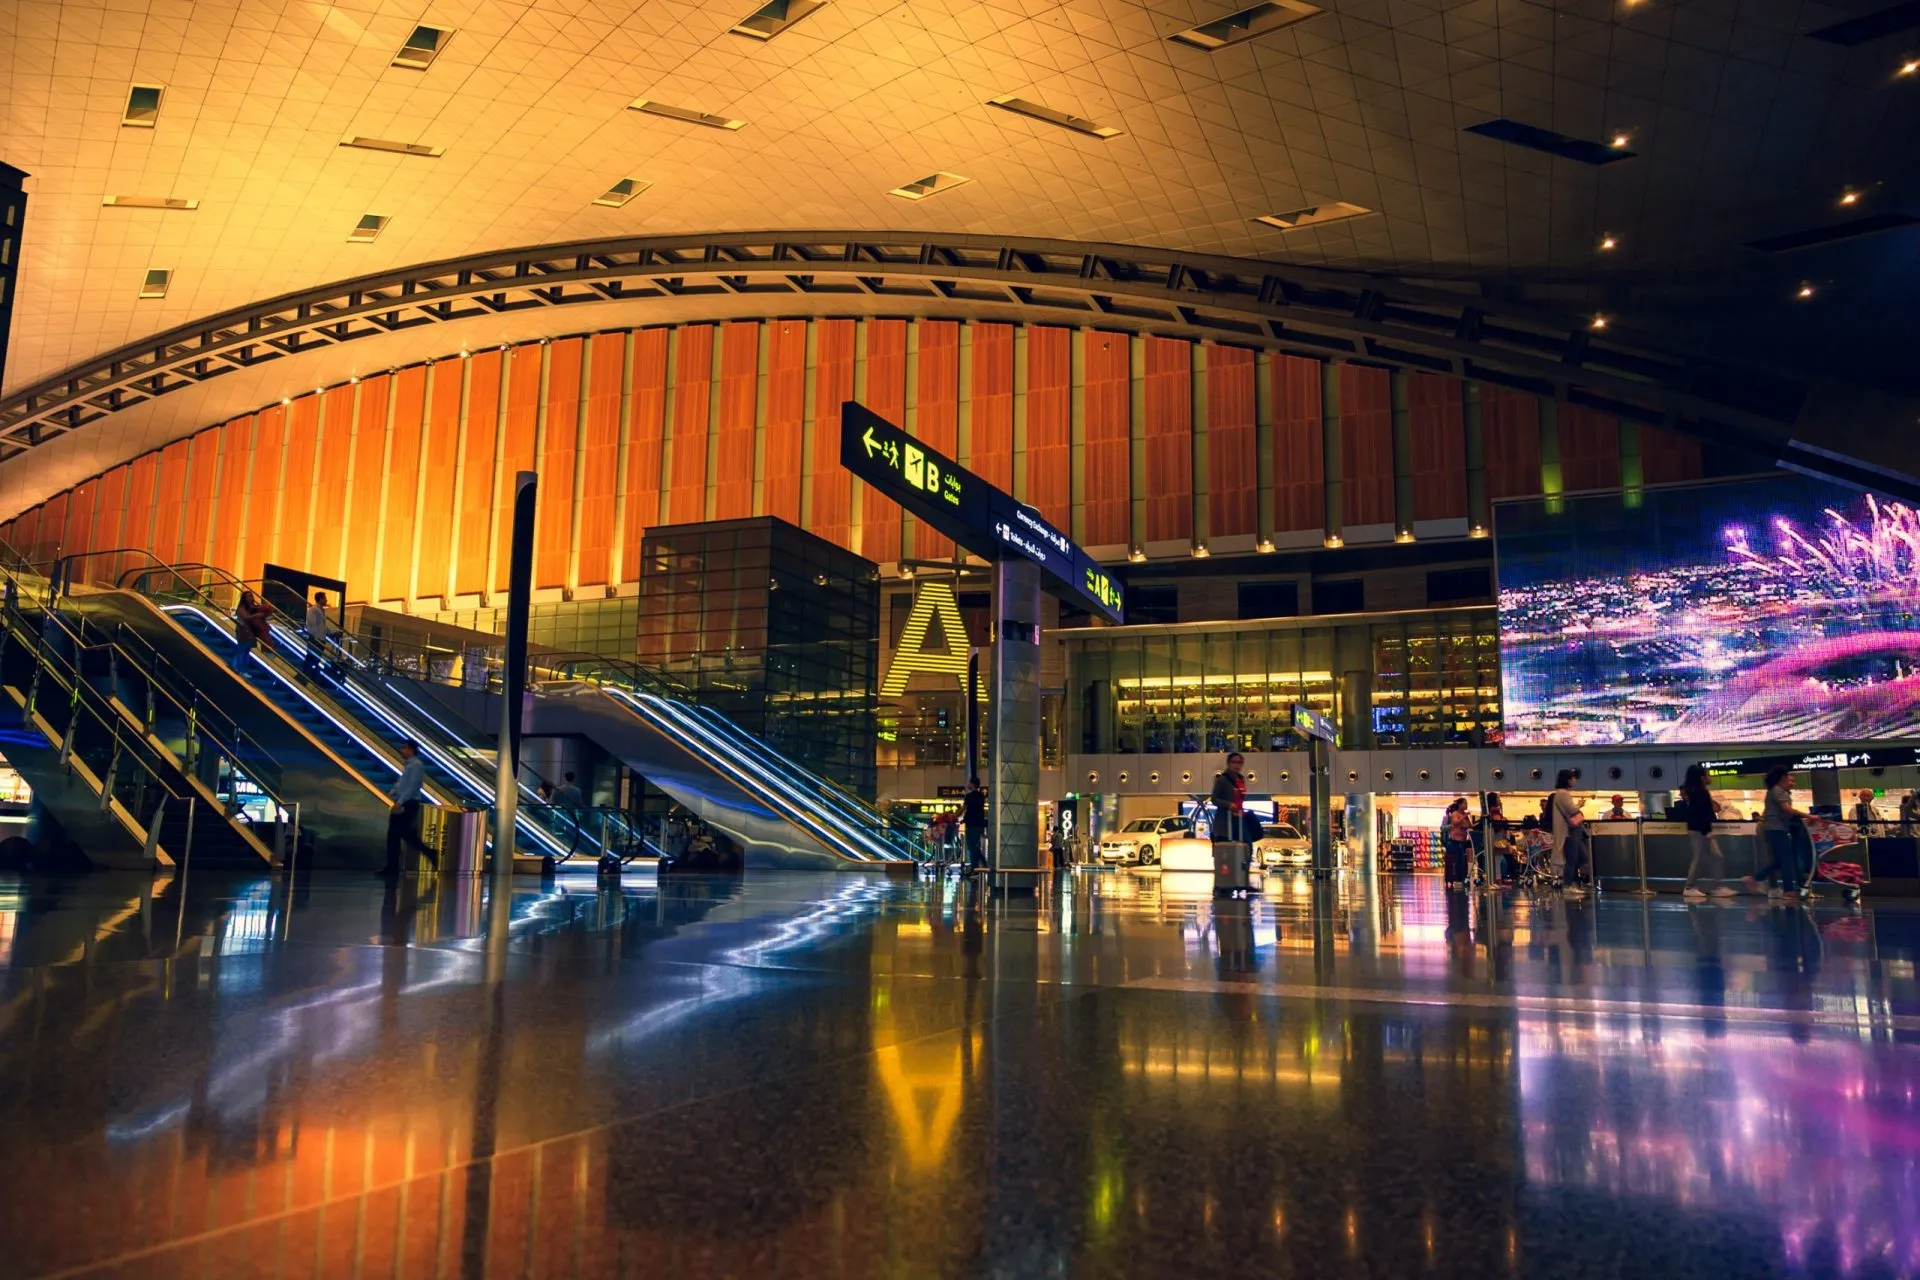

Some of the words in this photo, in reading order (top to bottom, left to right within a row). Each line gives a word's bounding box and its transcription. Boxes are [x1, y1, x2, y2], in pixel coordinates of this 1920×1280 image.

[927, 461, 940, 493] B
[1094, 574, 1101, 597] A
[879, 582, 990, 702] A
[928, 804, 936, 813] A
